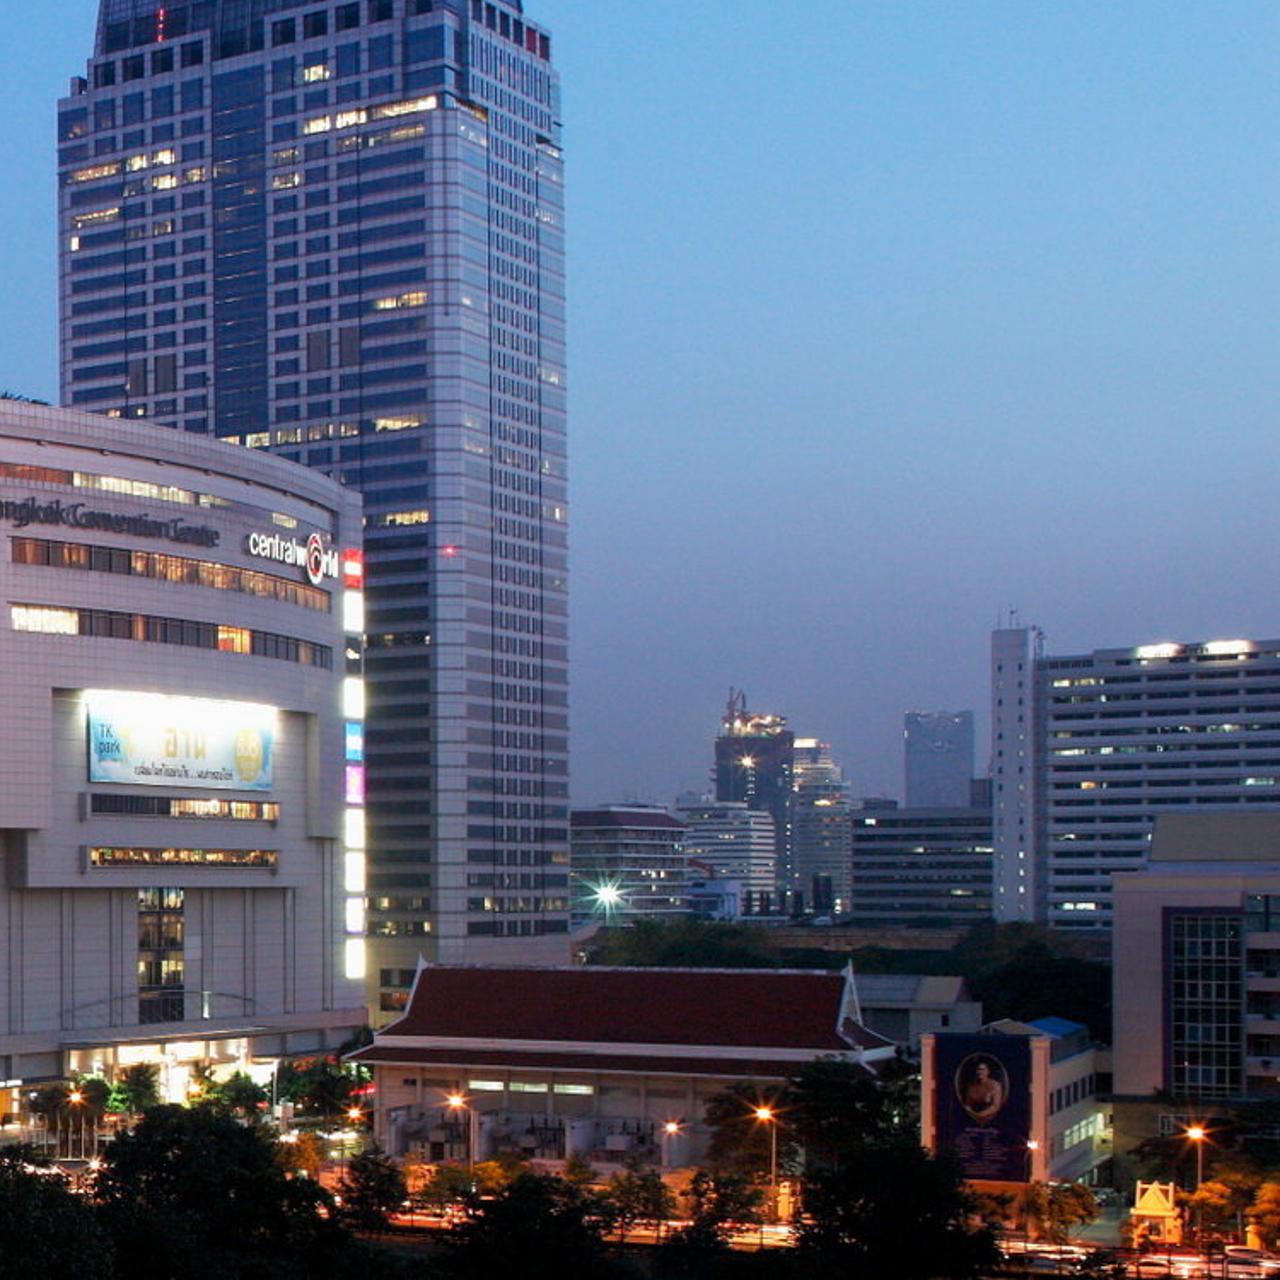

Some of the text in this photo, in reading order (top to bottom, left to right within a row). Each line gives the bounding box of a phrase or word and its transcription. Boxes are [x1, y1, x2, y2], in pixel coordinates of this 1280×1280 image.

[61, 502, 172, 538] Convention
[100, 724, 114, 738] TK
[98, 740, 121, 755] park
